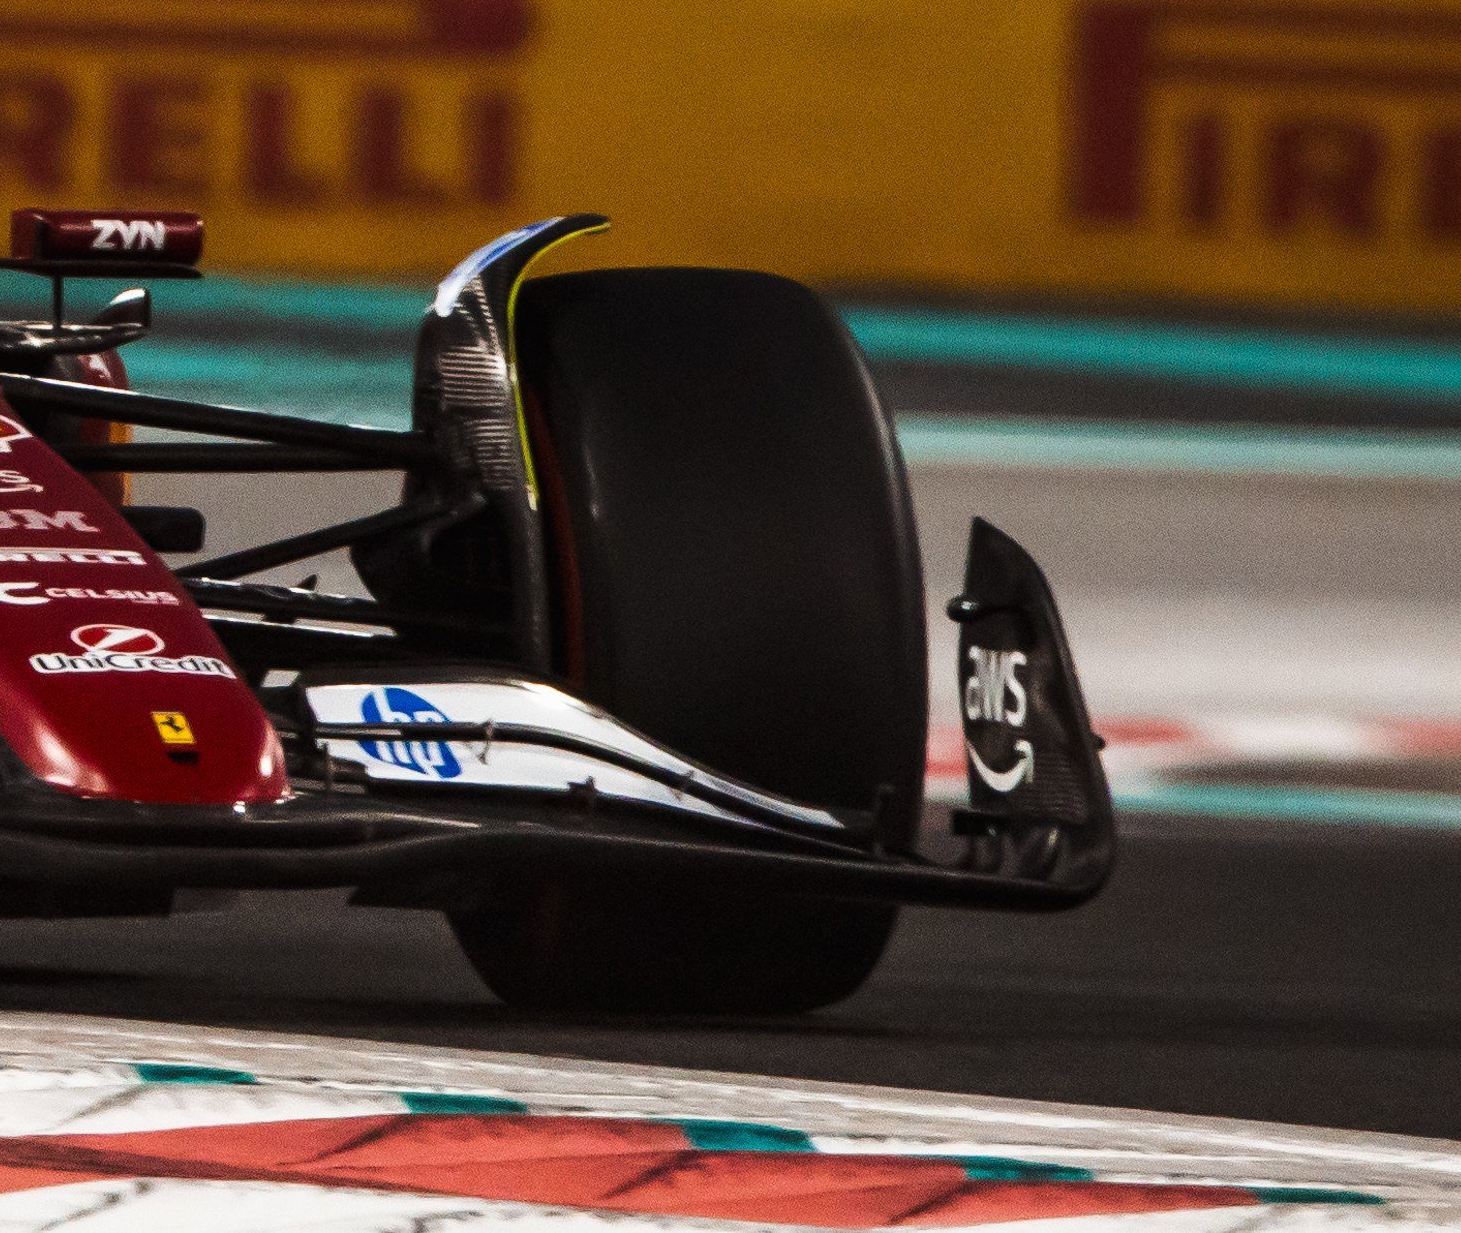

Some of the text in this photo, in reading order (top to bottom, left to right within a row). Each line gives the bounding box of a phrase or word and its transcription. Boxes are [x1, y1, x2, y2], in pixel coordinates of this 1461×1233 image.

[91, 219, 166, 250] ZYN
[45, 587, 179, 602] CELSIUS
[33, 652, 230, 676] UniCredit
[368, 687, 452, 777] hp
